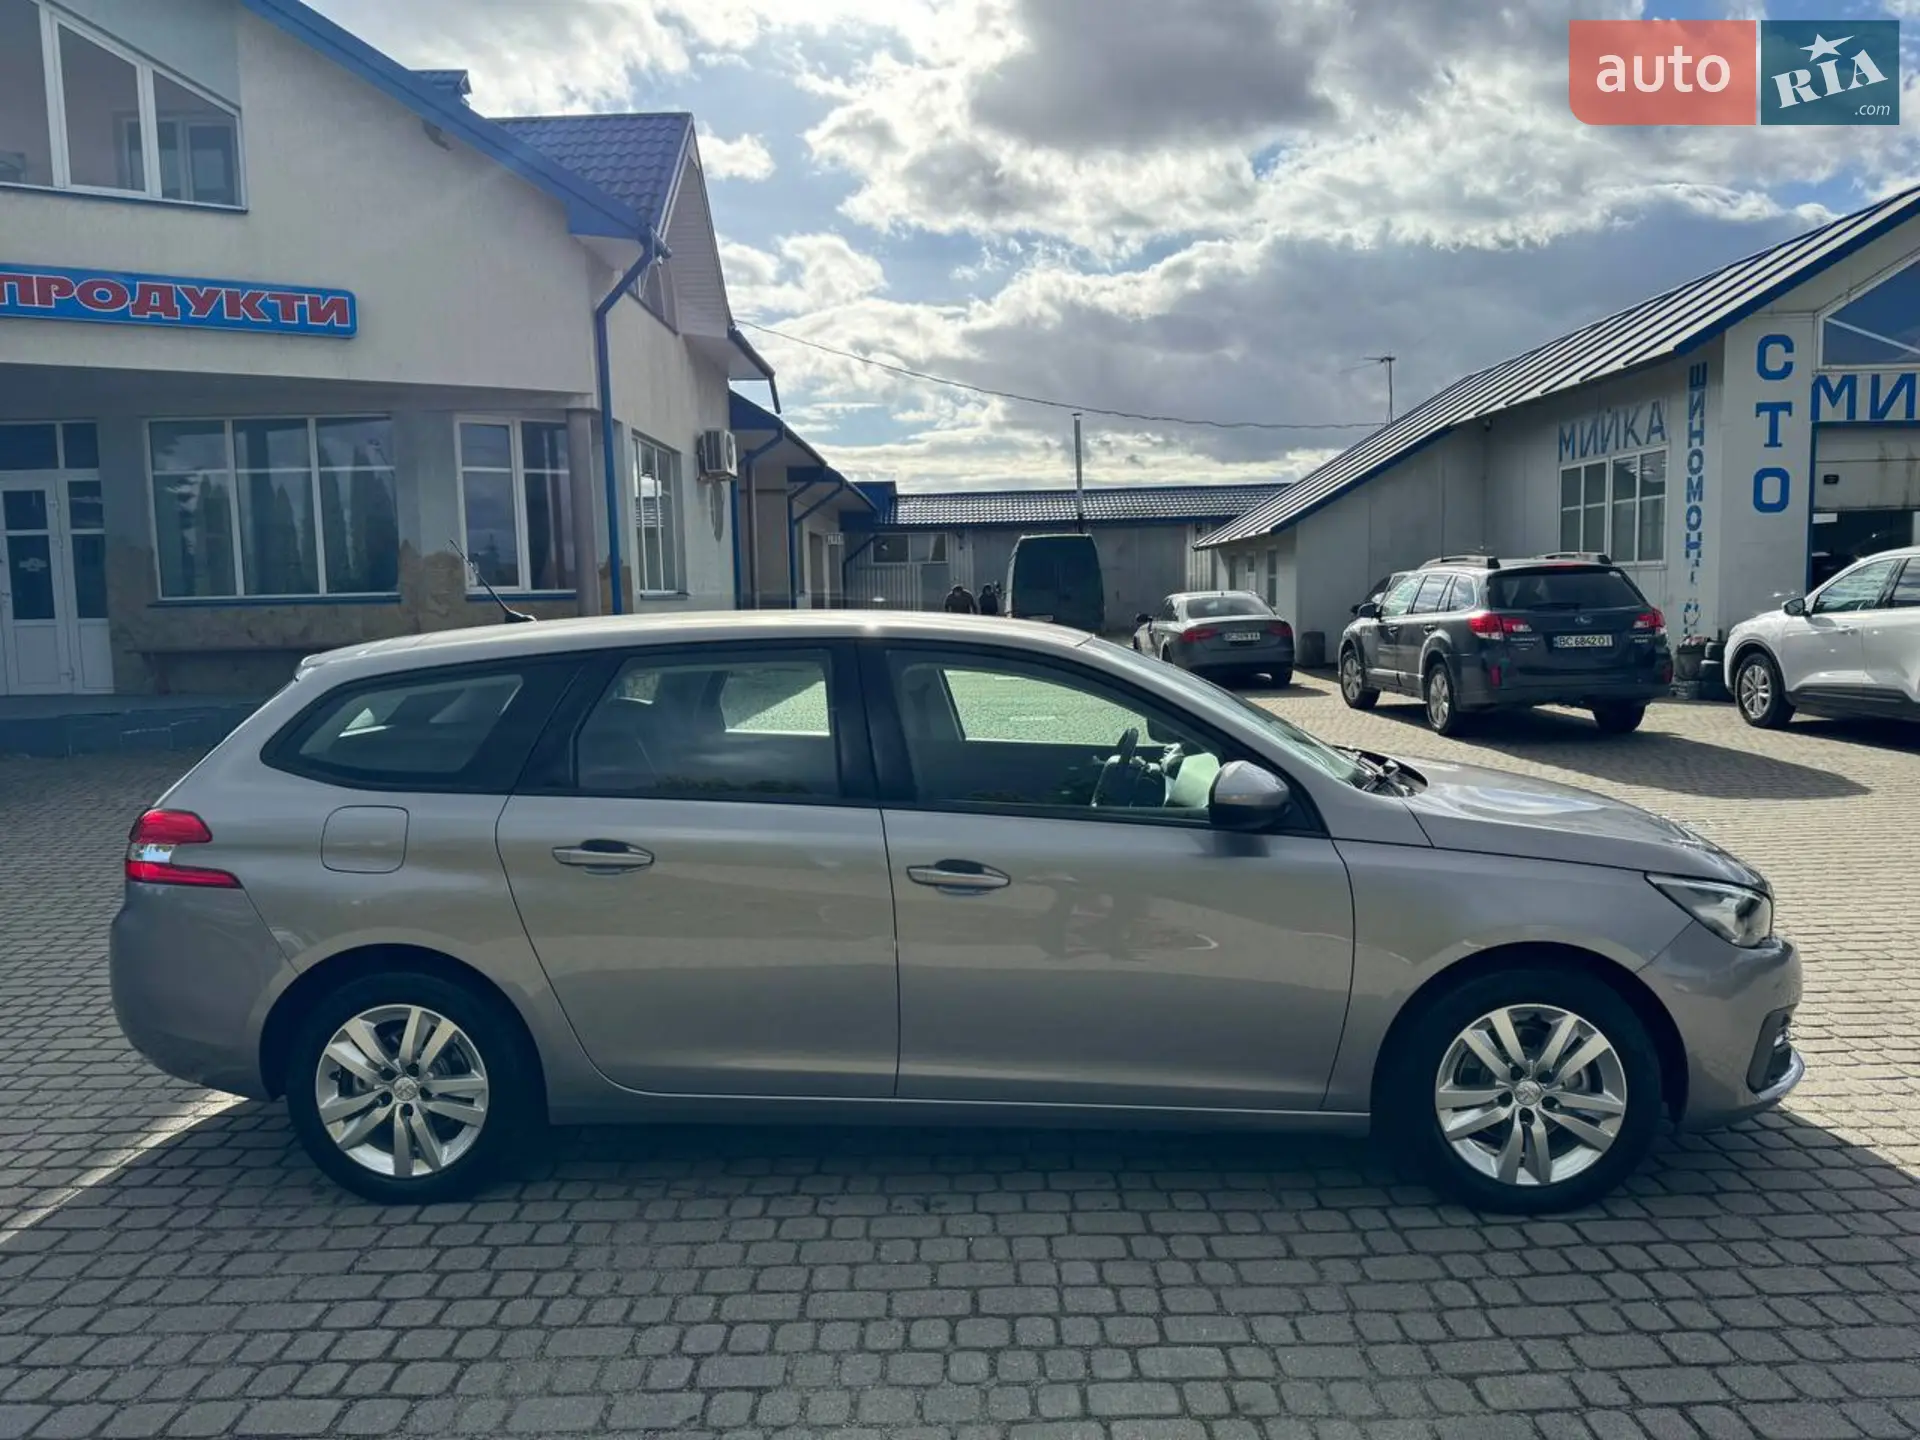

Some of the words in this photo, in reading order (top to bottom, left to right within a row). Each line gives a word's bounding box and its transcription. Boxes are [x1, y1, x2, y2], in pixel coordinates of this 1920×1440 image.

[0, 273, 351, 327] ПРОДУКТИ
[1559, 401, 1666, 462] МИЙКА
[1753, 334, 1794, 513] СТО
